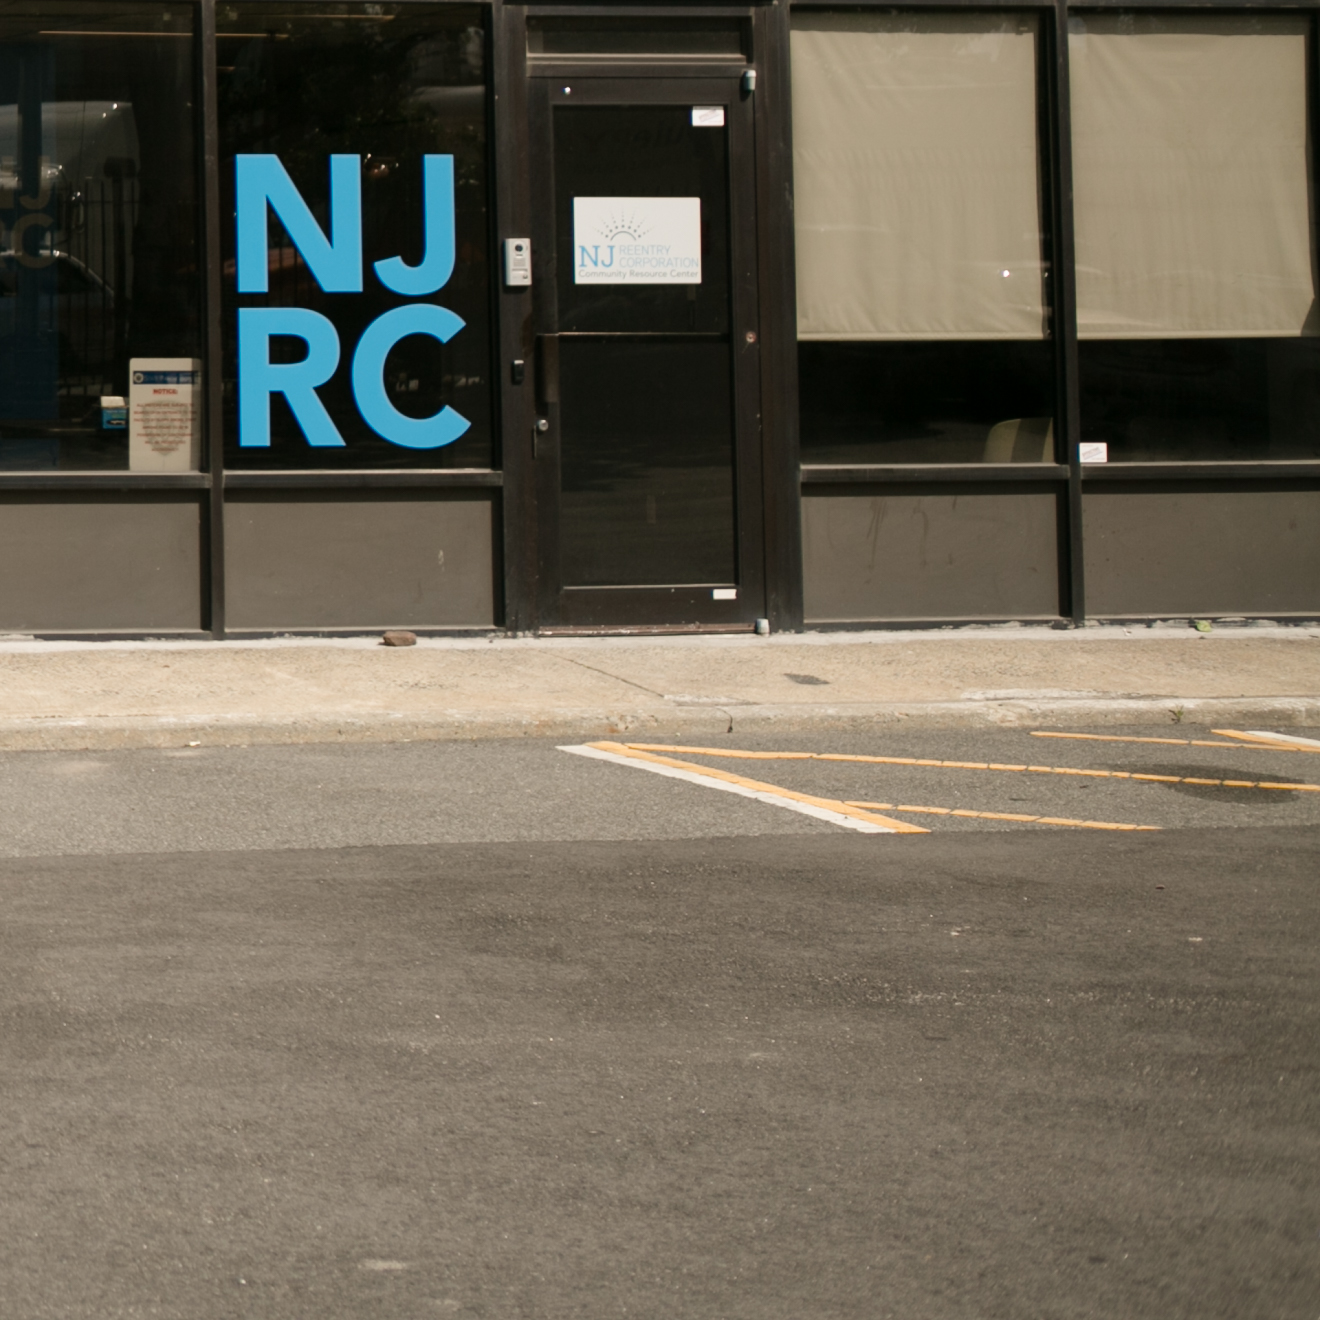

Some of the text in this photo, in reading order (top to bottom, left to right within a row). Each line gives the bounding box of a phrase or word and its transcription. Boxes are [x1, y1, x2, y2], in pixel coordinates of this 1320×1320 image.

[235, 153, 456, 296] NJ
[578, 244, 671, 268] NJ REENTRY
[619, 257, 699, 268] CORPORATION
[579, 269, 698, 279] Community Resource Center
[238, 303, 472, 450] RC
